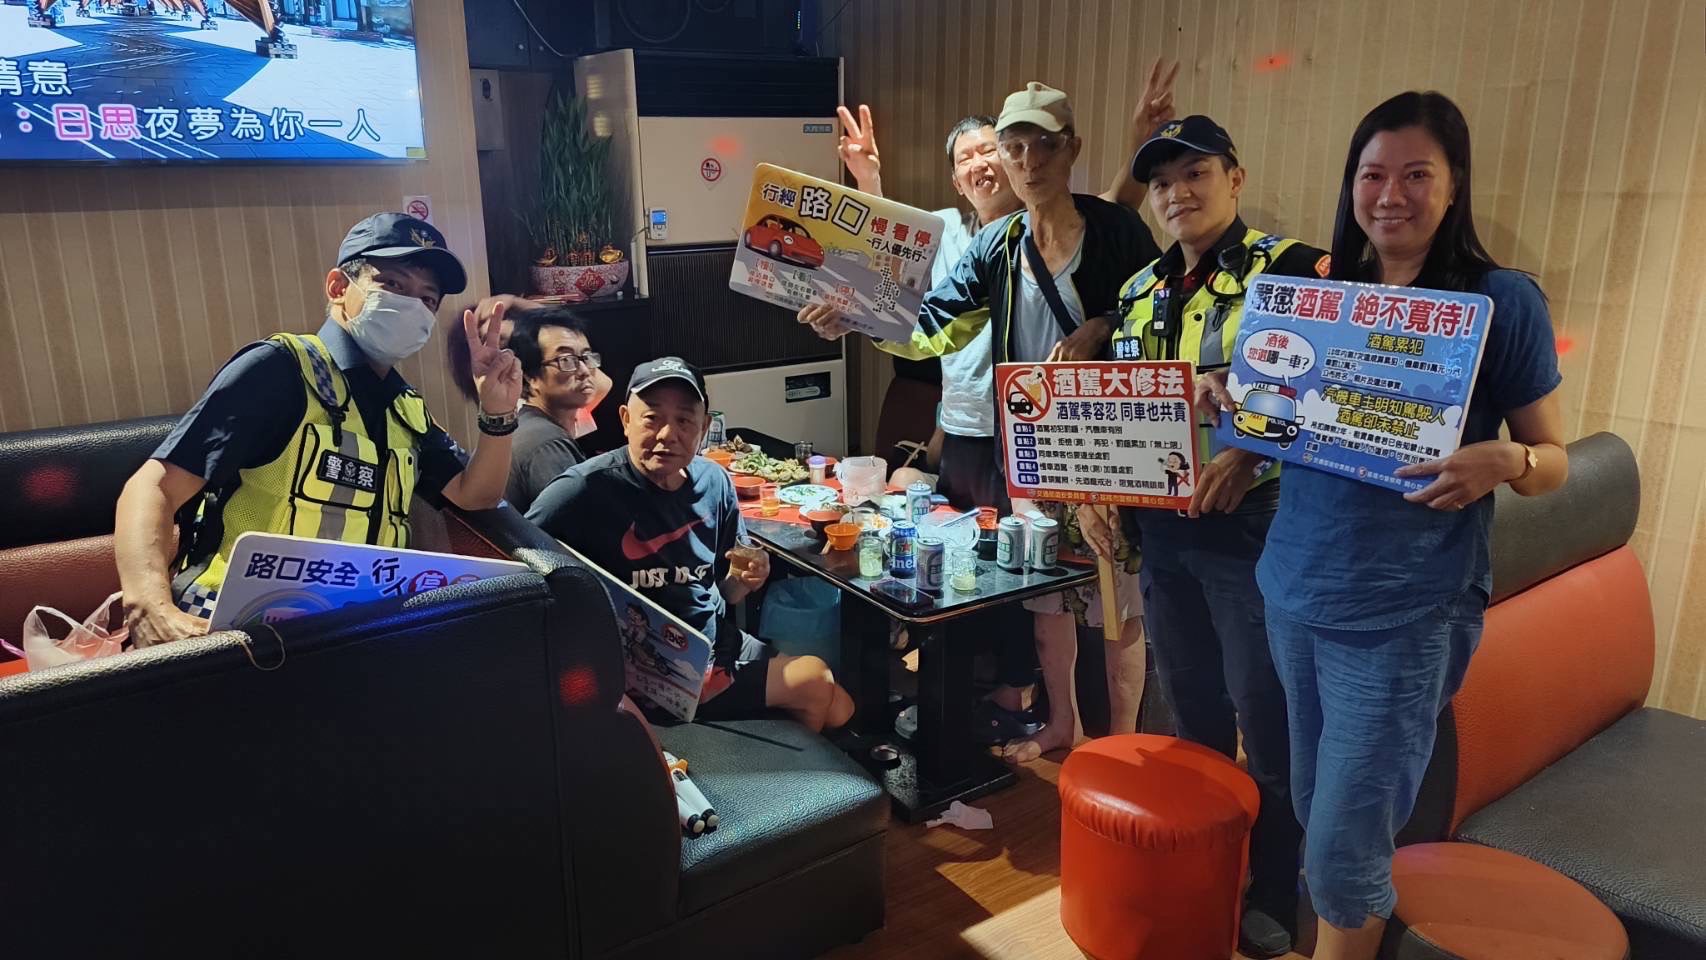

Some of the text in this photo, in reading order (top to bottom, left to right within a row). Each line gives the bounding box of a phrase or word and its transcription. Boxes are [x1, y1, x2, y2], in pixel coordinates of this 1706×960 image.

[1265, 332, 1290, 350] 酒後
[1367, 332, 1425, 356] 酒駕累犯
[1052, 367, 1185, 397] 酒駕大修法
[1056, 401, 1187, 423] 酒駕零容忍 同車也共責
[1320, 385, 1446, 426] 汽機車主明知駕駛人
[1336, 410, 1421, 440] 酒駕卻未禁止
[325, 454, 375, 488] 警察
[244, 552, 361, 588] 路口安全
[629, 567, 669, 590] JUST
